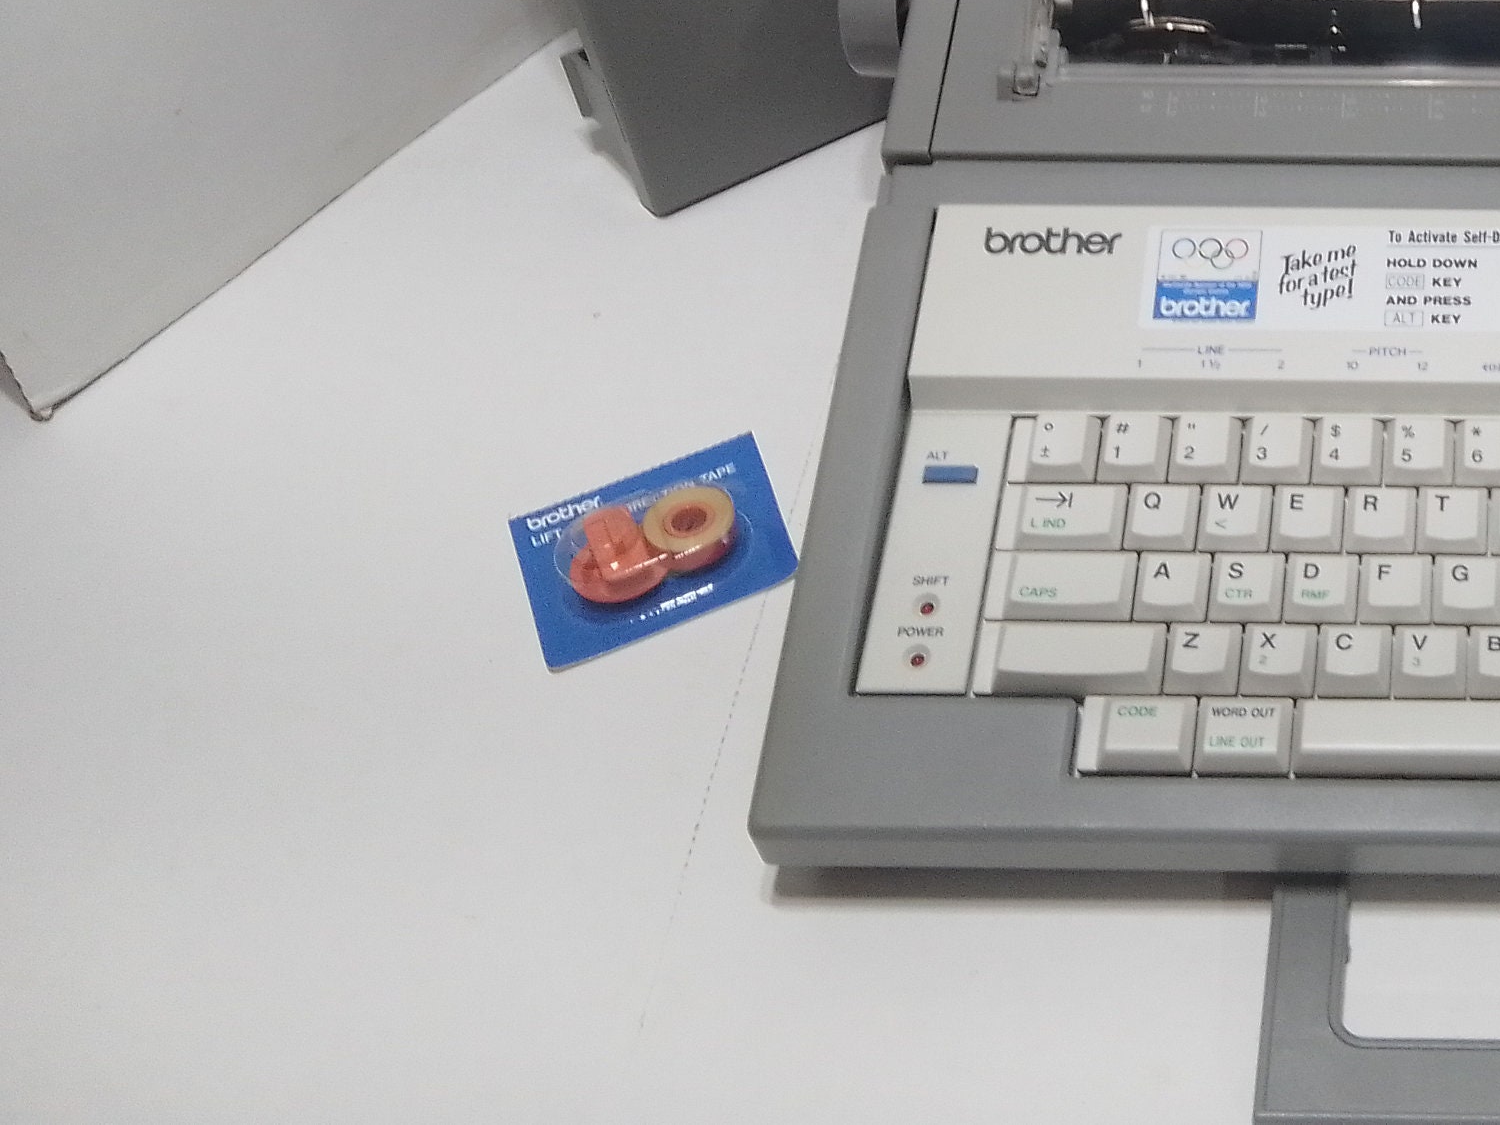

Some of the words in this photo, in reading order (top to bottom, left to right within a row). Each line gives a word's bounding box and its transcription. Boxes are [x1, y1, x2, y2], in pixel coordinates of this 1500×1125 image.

[984, 227, 1122, 254] brother
[1389, 230, 1402, 243] To
[1408, 231, 1457, 244] Activate
[1280, 250, 1324, 276] Take
[1327, 245, 1356, 267] me
[1387, 259, 1426, 268] HOLD
[1433, 259, 1478, 269] DOWN
[1279, 274, 1304, 295] for
[1308, 274, 1320, 287] a
[1322, 260, 1358, 284] test
[1388, 276, 1423, 288] CODE
[1433, 277, 1462, 287] KEY
[1301, 276, 1354, 310] type!
[1160, 296, 1250, 317] brother
[1387, 296, 1417, 305] AND
[1424, 296, 1472, 306] PRESS
[1393, 312, 1415, 324] ALT
[1431, 314, 1461, 324] KEY
[1197, 346, 1224, 355] LINE
[1369, 347, 1407, 357] PITCH
[1116, 423, 1129, 434] #
[1330, 424, 1341, 438] $
[1402, 425, 1415, 439] %
[926, 451, 948, 461] ALT
[1114, 446, 1120, 458] 1
[1184, 446, 1194, 459] 2
[1256, 447, 1268, 460] 3
[1329, 447, 1340, 461] 4
[1401, 449, 1412, 462] 5
[1471, 449, 1483, 463] 6
[700, 462, 736, 482] TAPE
[1144, 492, 1162, 510] Q
[1218, 493, 1238, 510] W
[1290, 494, 1304, 509] E
[1364, 495, 1378, 511] R
[1435, 496, 1449, 511] T
[526, 496, 601, 532] brother
[529, 527, 564, 548] LIFT
[1154, 563, 1171, 579] A
[1228, 563, 1244, 579] S
[1303, 564, 1320, 579] D
[1378, 564, 1392, 579] F
[1452, 565, 1469, 581] G
[912, 576, 948, 586] SHIFT
[1019, 586, 1057, 598] CAPS
[1225, 588, 1253, 598] CTR
[1301, 588, 1330, 600] RMF
[898, 627, 944, 637] POWER
[1183, 632, 1200, 648] Z
[1260, 633, 1277, 648] X
[1335, 634, 1352, 650] C
[1412, 635, 1428, 650] V
[1117, 705, 1158, 717] CODE
[1211, 707, 1247, 717] WORD
[1251, 707, 1275, 717] OUT
[1209, 736, 1236, 747] LINE
[1241, 737, 1264, 748] OUT
